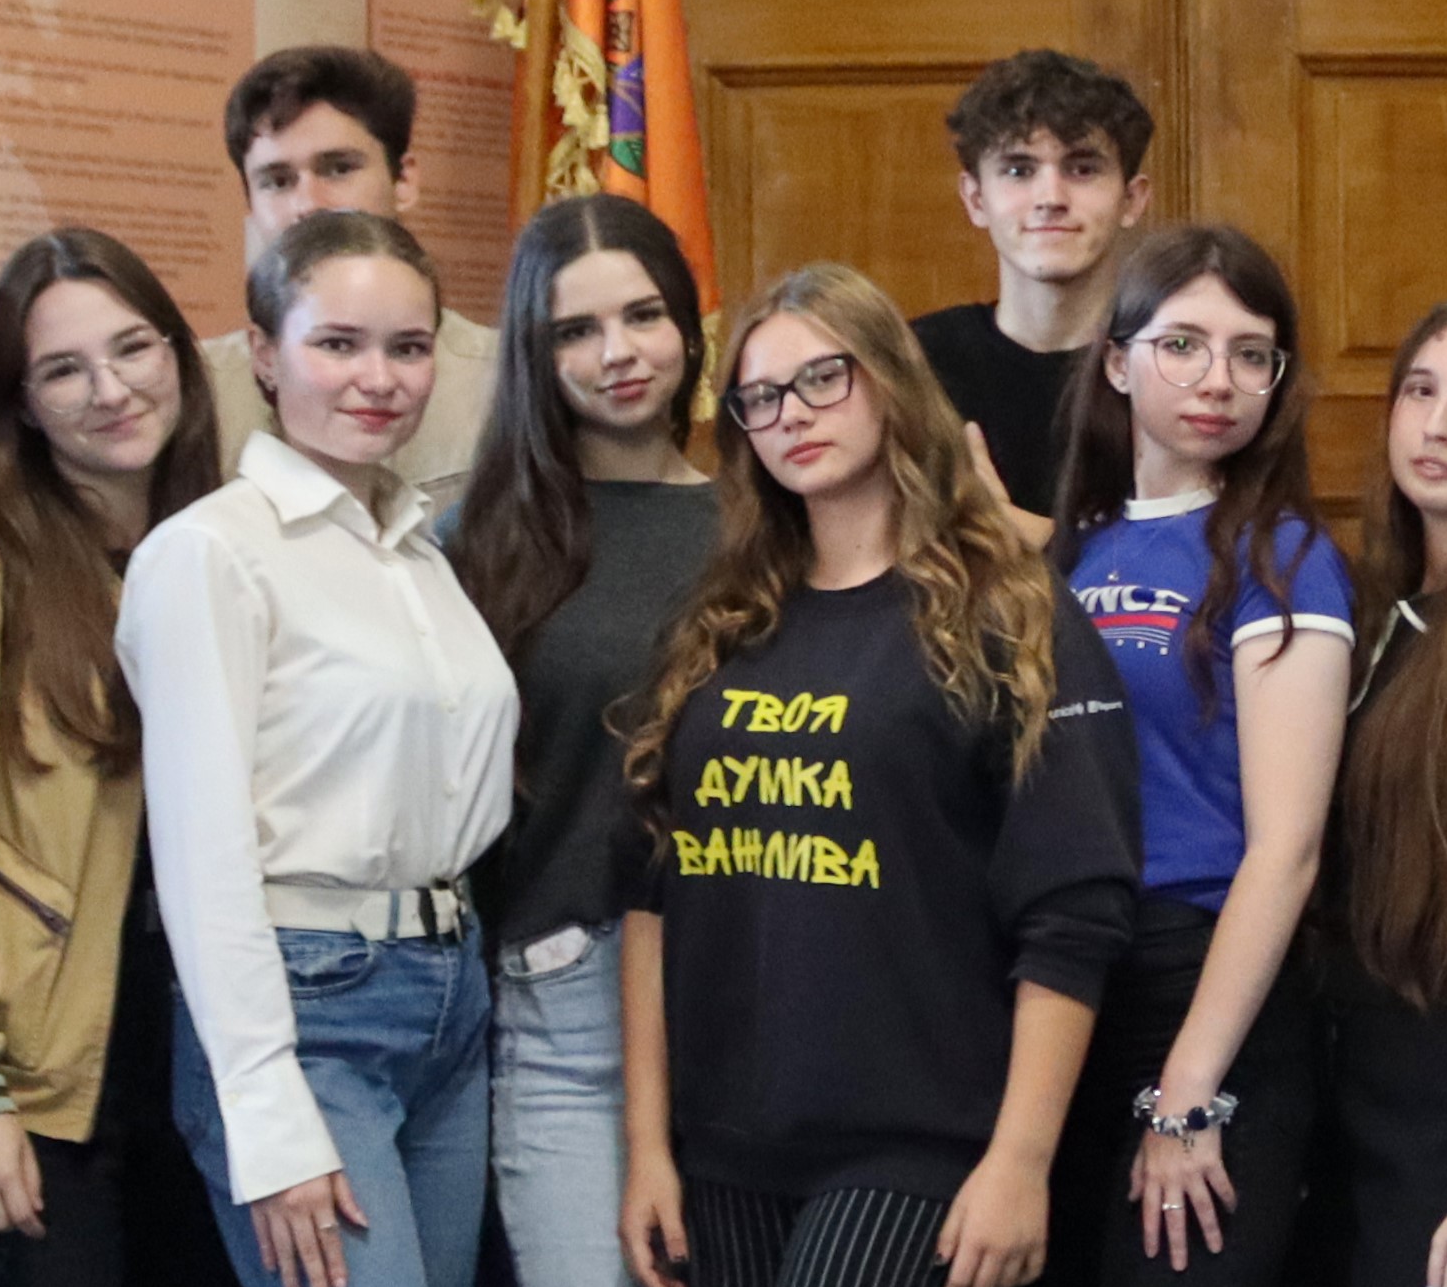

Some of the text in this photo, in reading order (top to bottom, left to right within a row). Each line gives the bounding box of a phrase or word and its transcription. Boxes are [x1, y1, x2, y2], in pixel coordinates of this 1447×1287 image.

[721, 689, 849, 734] ТВОЯ
[694, 756, 853, 810] ДУМКА
[671, 826, 880, 890] ВАЖЛИВА
